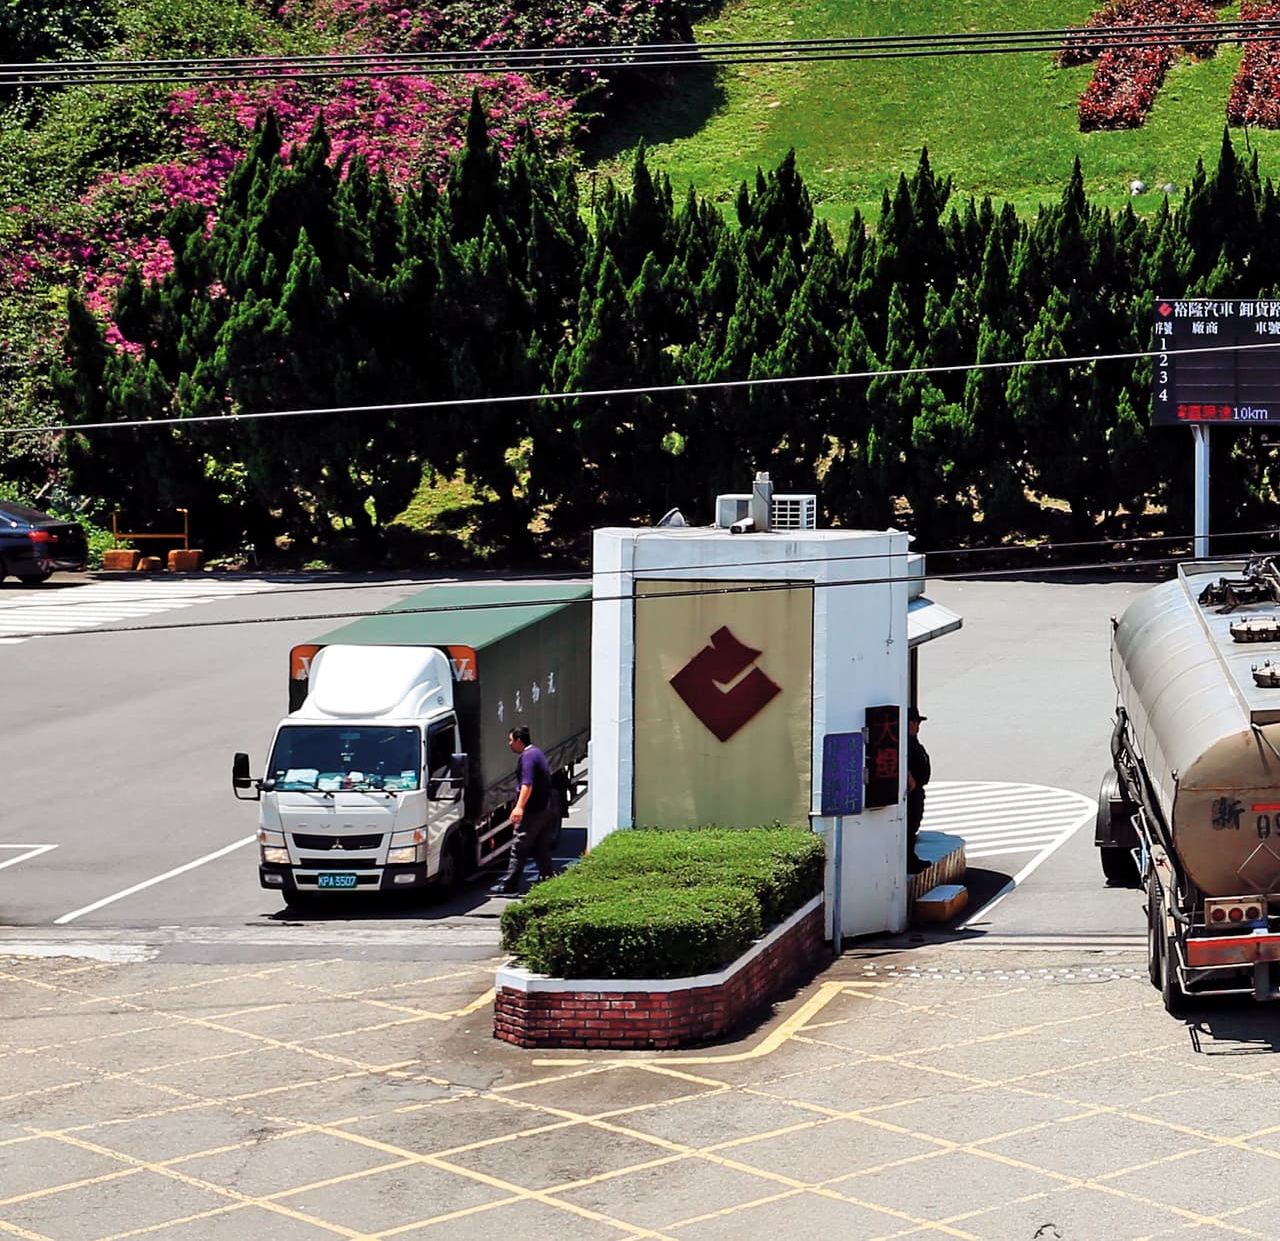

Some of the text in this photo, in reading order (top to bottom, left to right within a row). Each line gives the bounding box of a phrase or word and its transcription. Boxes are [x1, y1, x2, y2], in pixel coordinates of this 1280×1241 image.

[1174, 301, 1234, 318] 裕隆汽車
[1160, 337, 1167, 351] 1
[1159, 353, 1169, 367] 2
[1159, 370, 1168, 384] 3
[1158, 388, 1169, 402] 4
[1233, 407, 1268, 420] 10km
